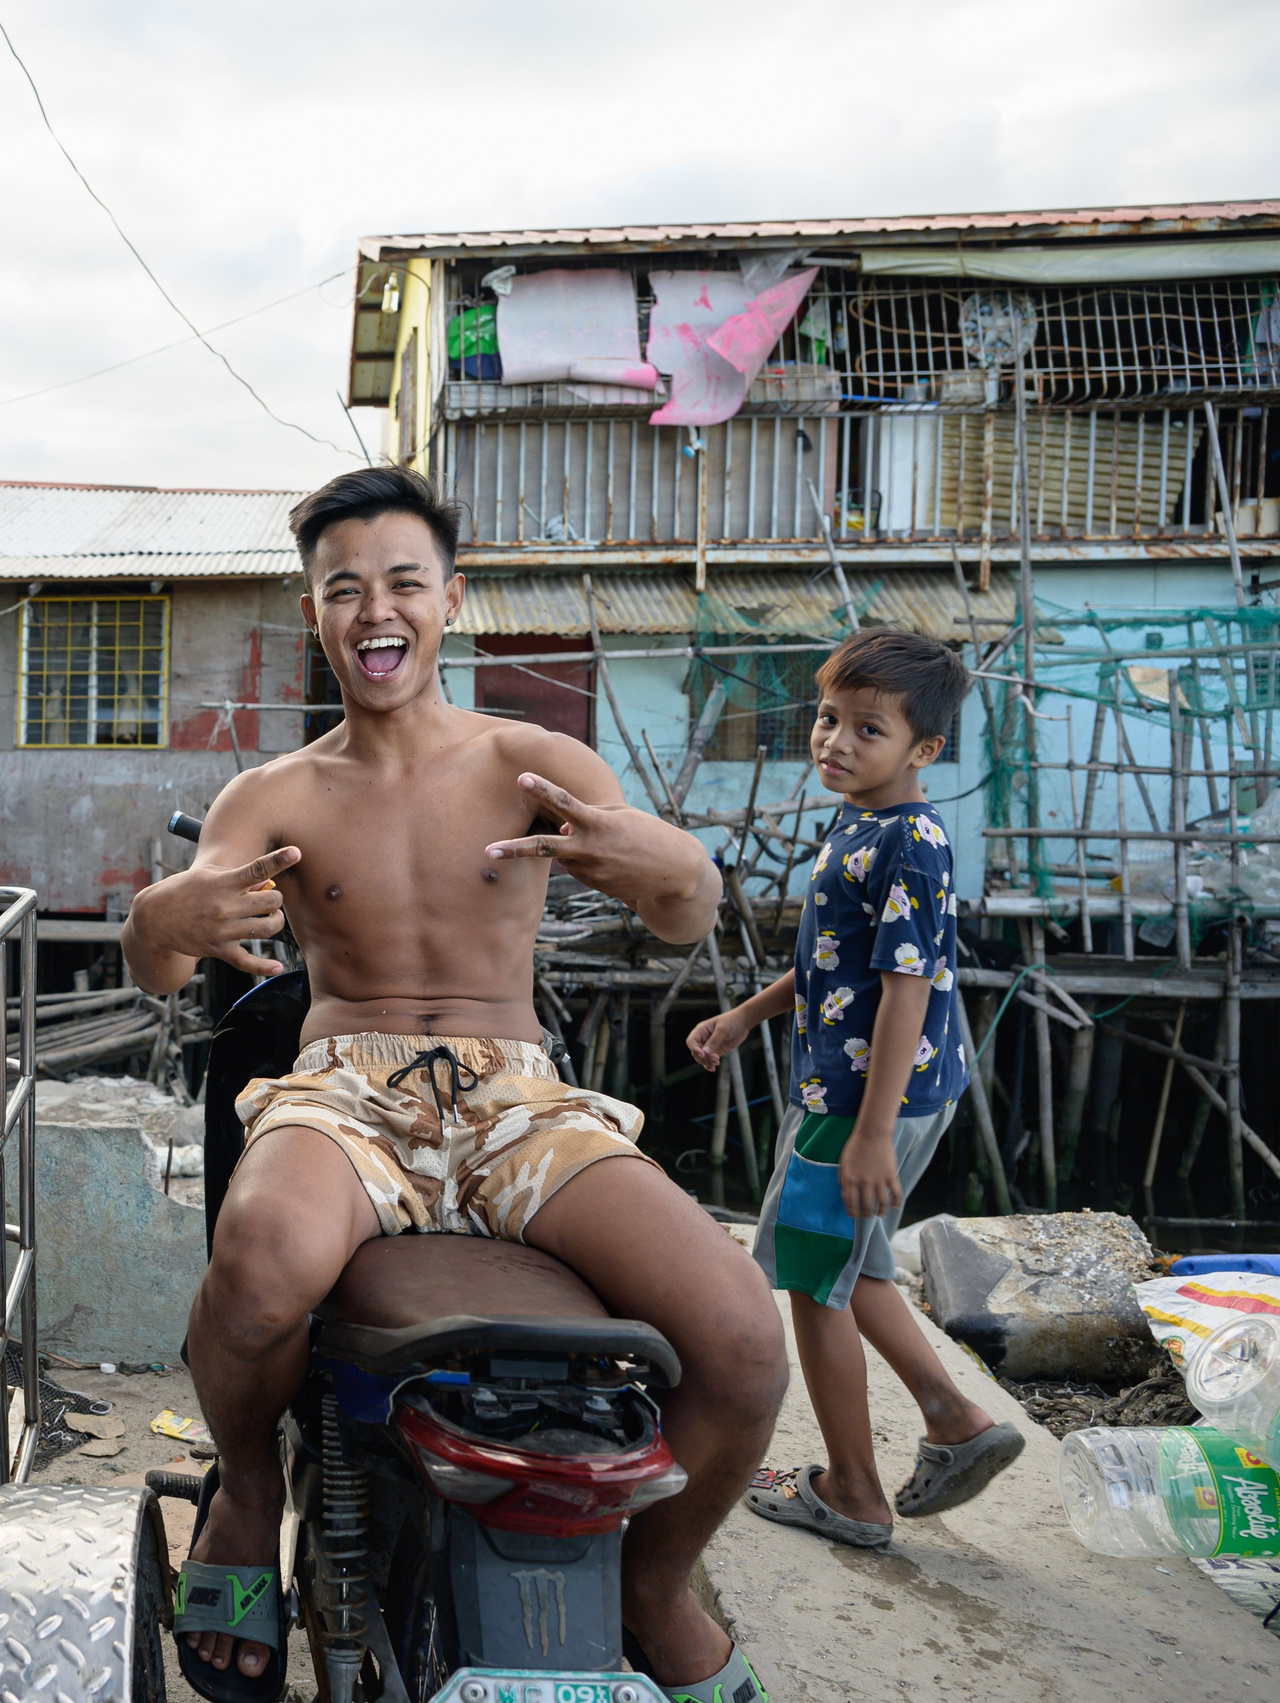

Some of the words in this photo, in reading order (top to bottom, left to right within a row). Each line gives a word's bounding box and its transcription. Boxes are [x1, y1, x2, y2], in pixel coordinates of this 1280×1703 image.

[1222, 1474, 1279, 1539] Absolute
[187, 1586, 221, 1607] NIKE
[239, 1593, 255, 1611] AIR
[251, 1577, 268, 1597] MAX
